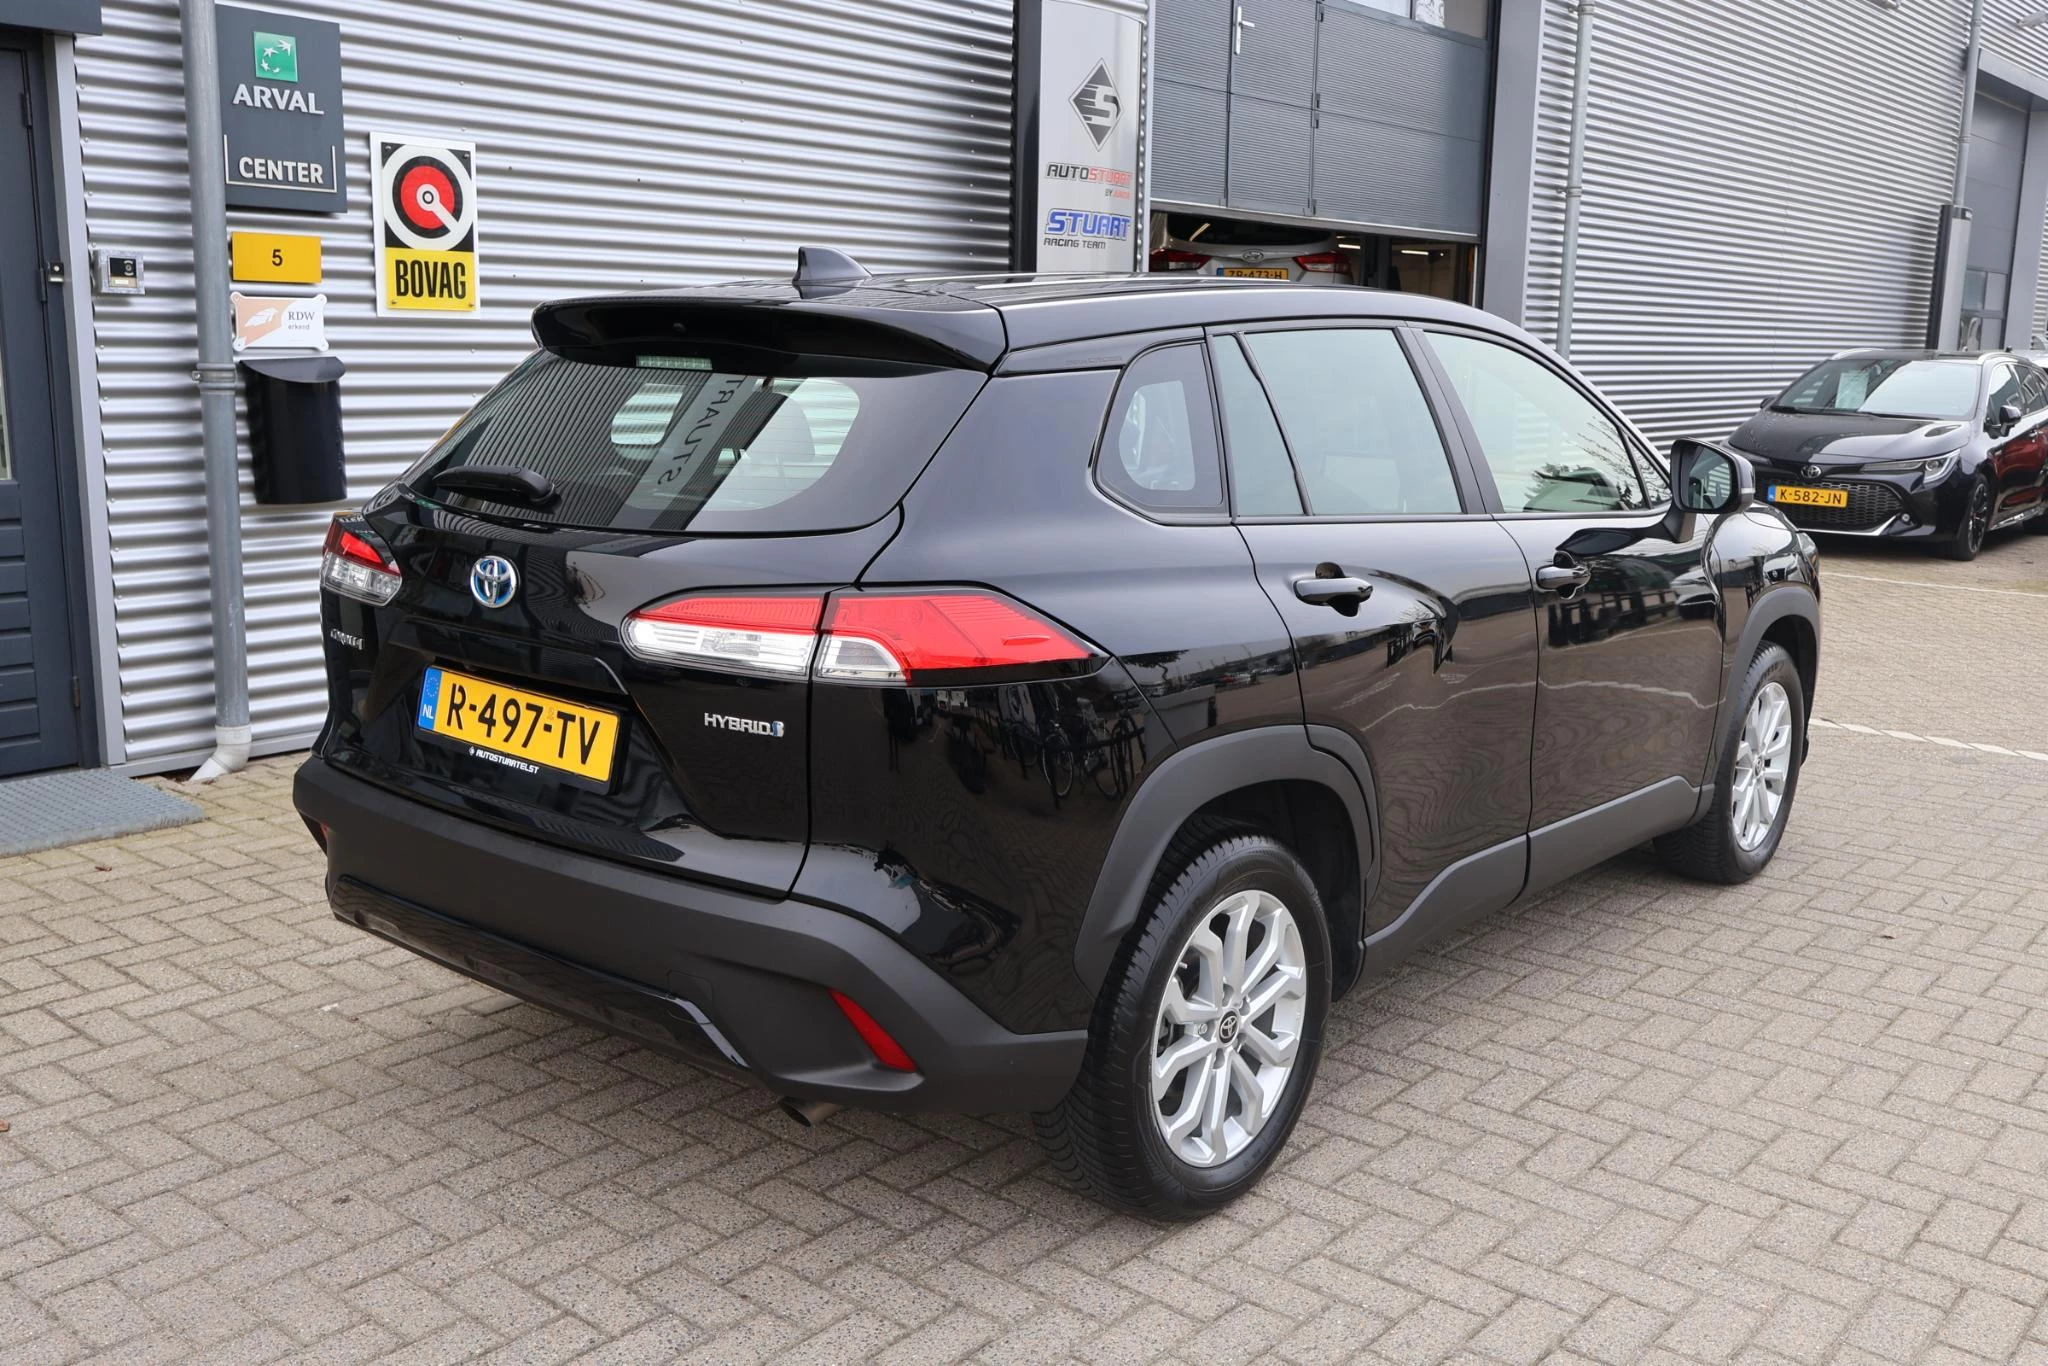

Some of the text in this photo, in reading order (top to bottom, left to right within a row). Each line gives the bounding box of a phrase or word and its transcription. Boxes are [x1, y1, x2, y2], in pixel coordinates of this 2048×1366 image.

[232, 83, 324, 114] ARVAL
[238, 156, 324, 184] CENTER
[1047, 211, 1131, 238] STUART
[1043, 238, 1106, 249] RACING TEAM
[271, 249, 283, 267] 5
[395, 259, 467, 299] BOVAG
[288, 311, 316, 321] RDW
[1780, 488, 1842, 504] K-582-JN
[422, 703, 434, 719] NL
[446, 683, 601, 766] R-497-TV
[704, 712, 771, 735] HYBRID
[475, 749, 540, 775] AUTOSTUARTELST
